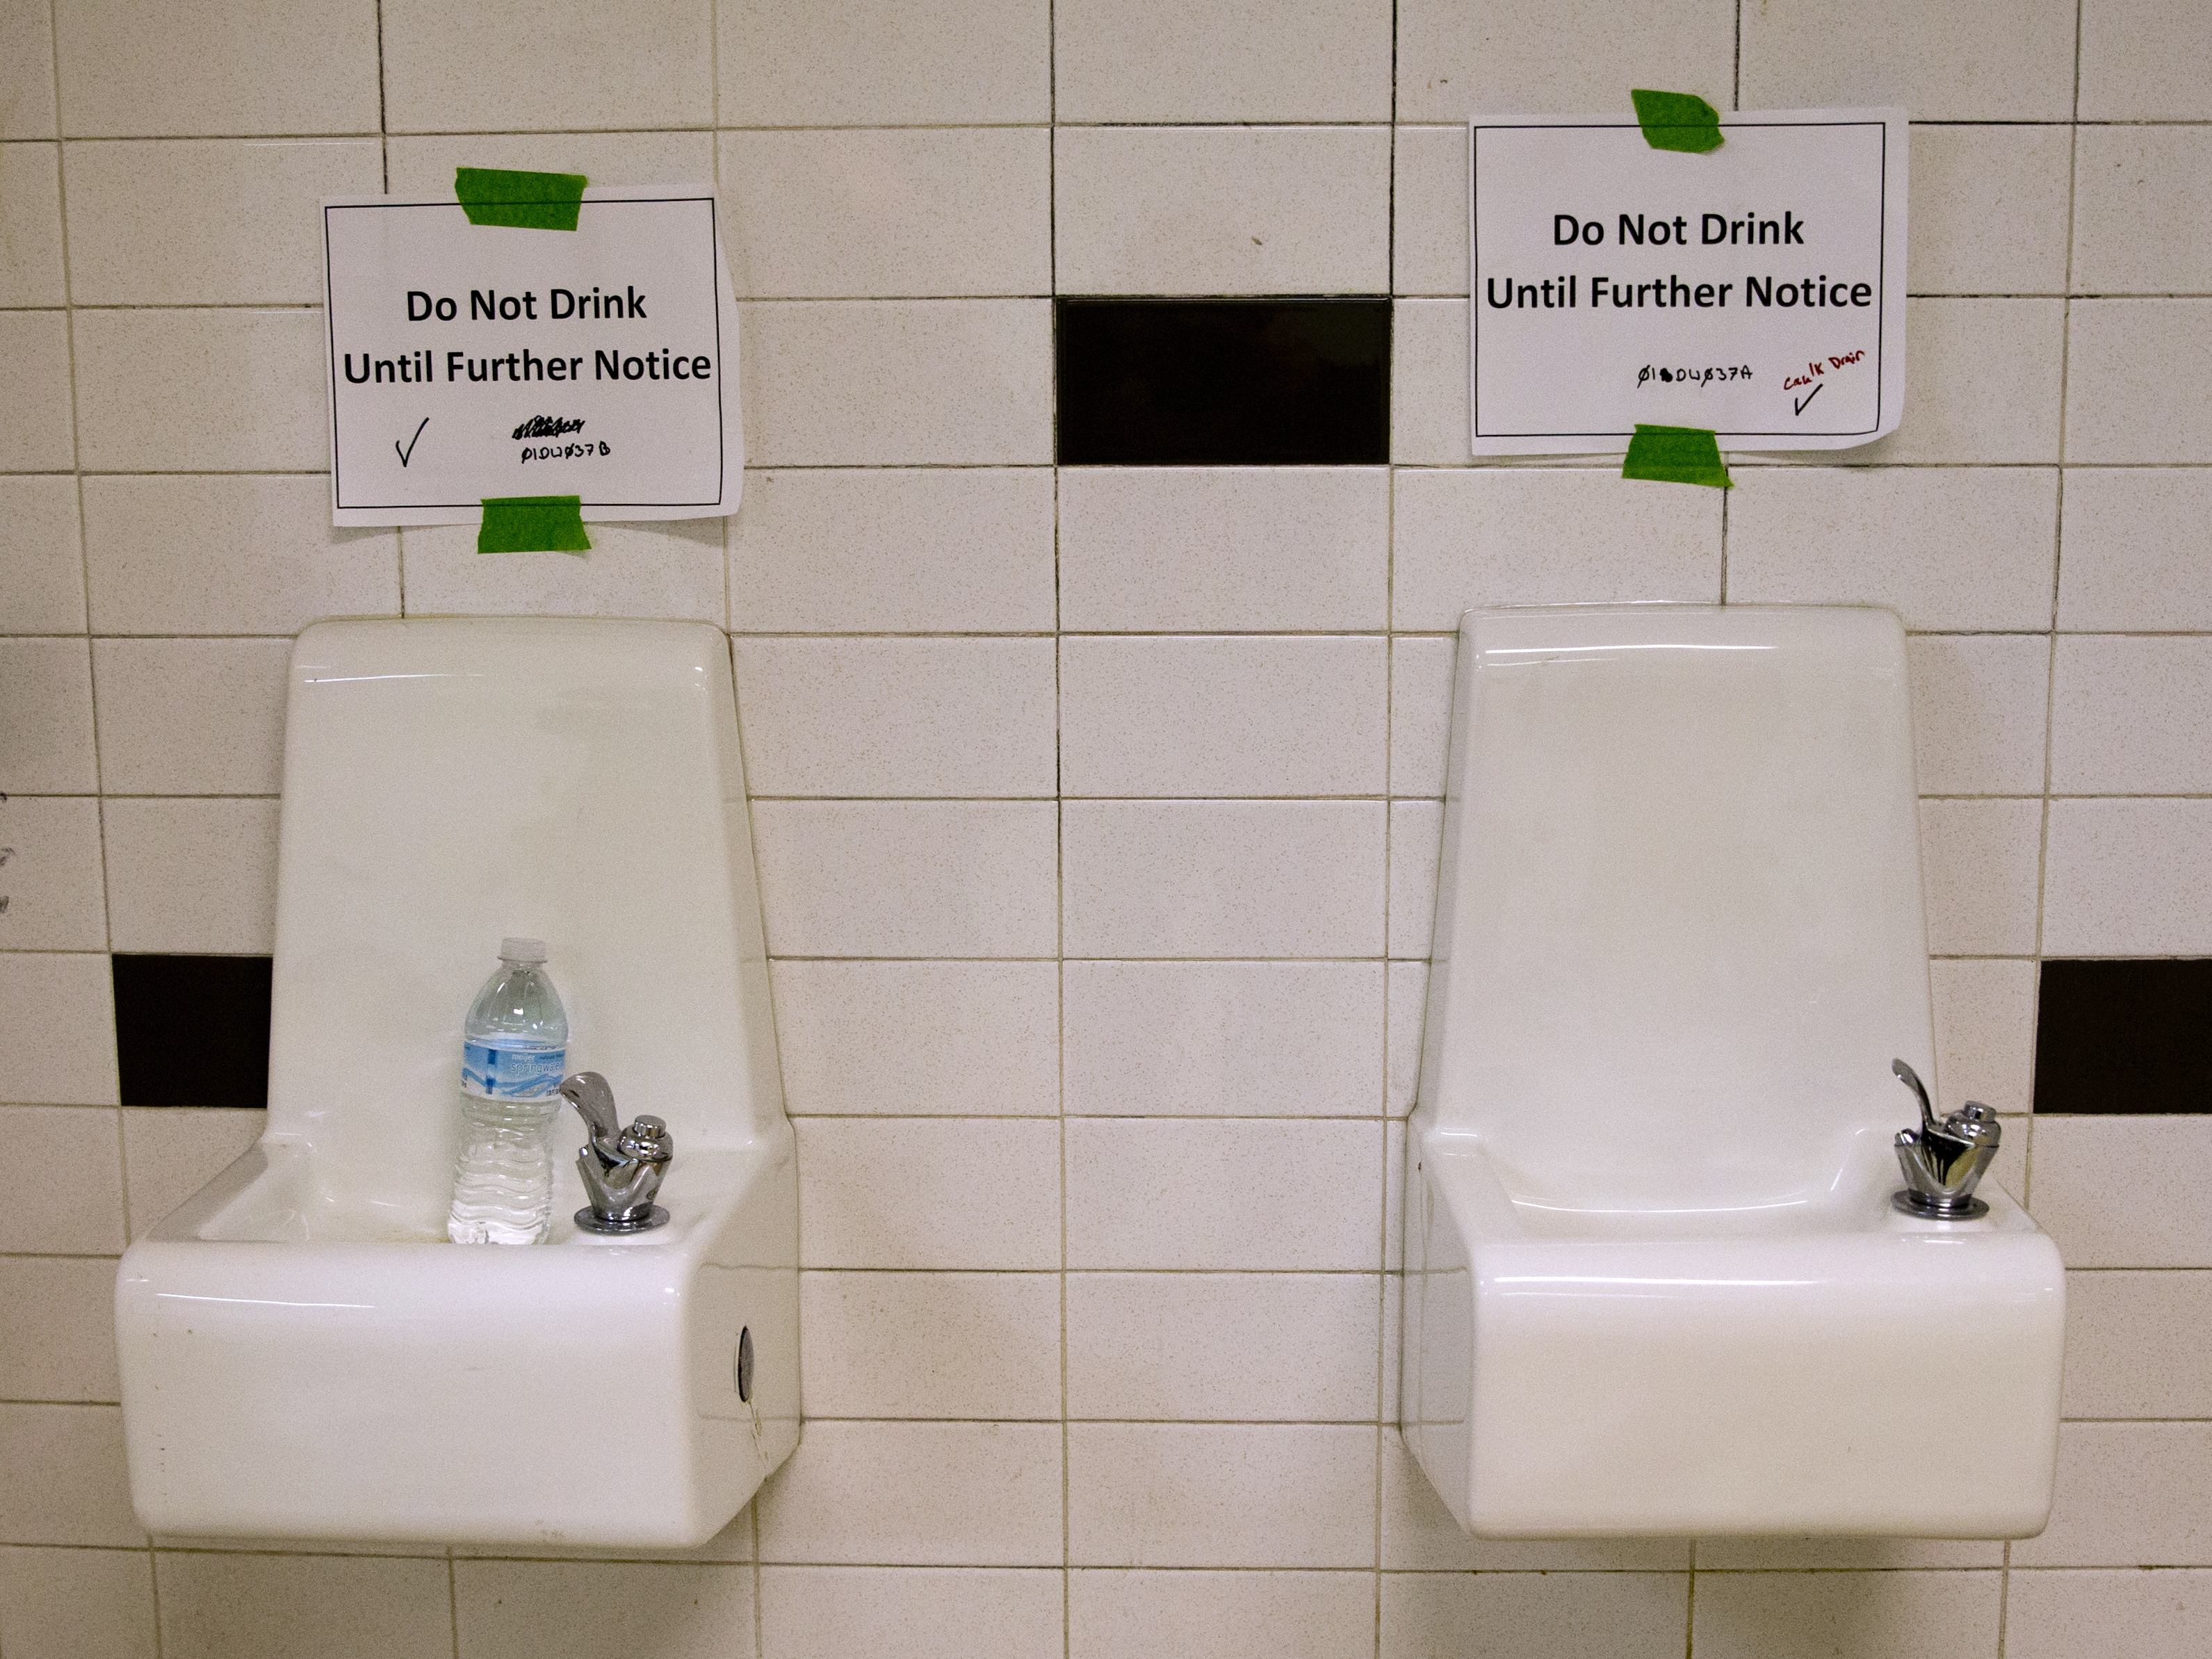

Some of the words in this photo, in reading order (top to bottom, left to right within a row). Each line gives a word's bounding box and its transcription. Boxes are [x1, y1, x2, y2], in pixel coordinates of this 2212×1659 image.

[1554, 214, 1604, 246] Do
[1618, 213, 1687, 245] Not
[1701, 211, 1805, 245] Drink
[407, 291, 457, 322] Do
[470, 289, 537, 320] Not
[551, 285, 647, 320] Drink
[1487, 275, 1577, 309] Until
[1591, 274, 1733, 308] Further
[1746, 275, 1872, 308] Notice
[344, 350, 433, 384] Until
[447, 348, 583, 382] Further
[595, 348, 711, 381] Notice
